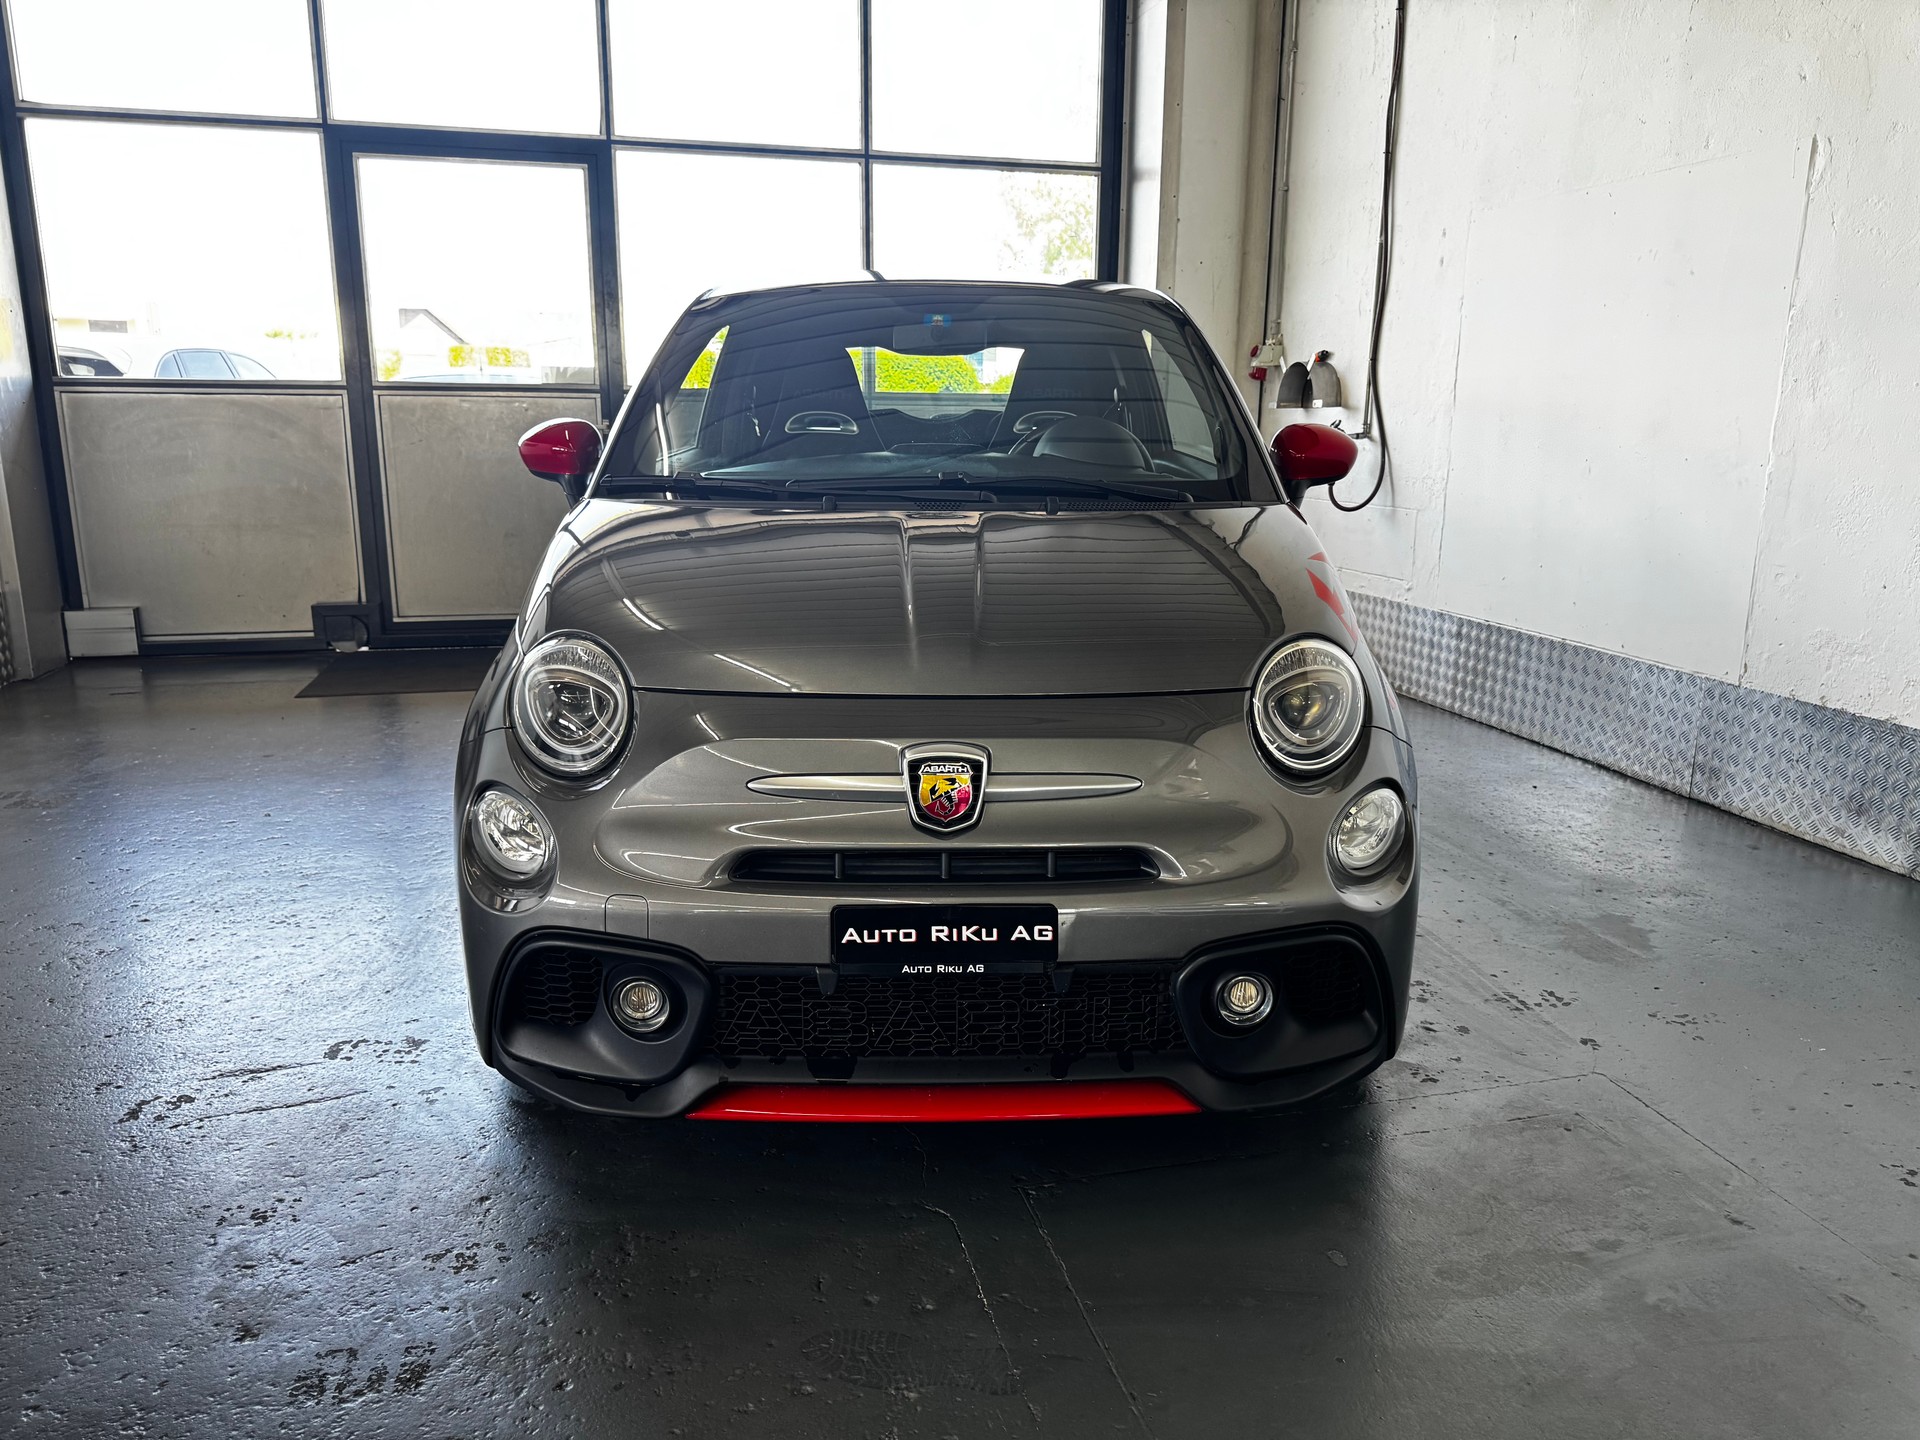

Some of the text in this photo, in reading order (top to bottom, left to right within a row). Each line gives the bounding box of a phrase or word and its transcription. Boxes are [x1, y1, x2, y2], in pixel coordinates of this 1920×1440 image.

[923, 765, 967, 773] ABARTH
[1010, 925, 1054, 941] AG
[966, 964, 985, 973] AG
[720, 994, 1159, 1047] ABARTH
